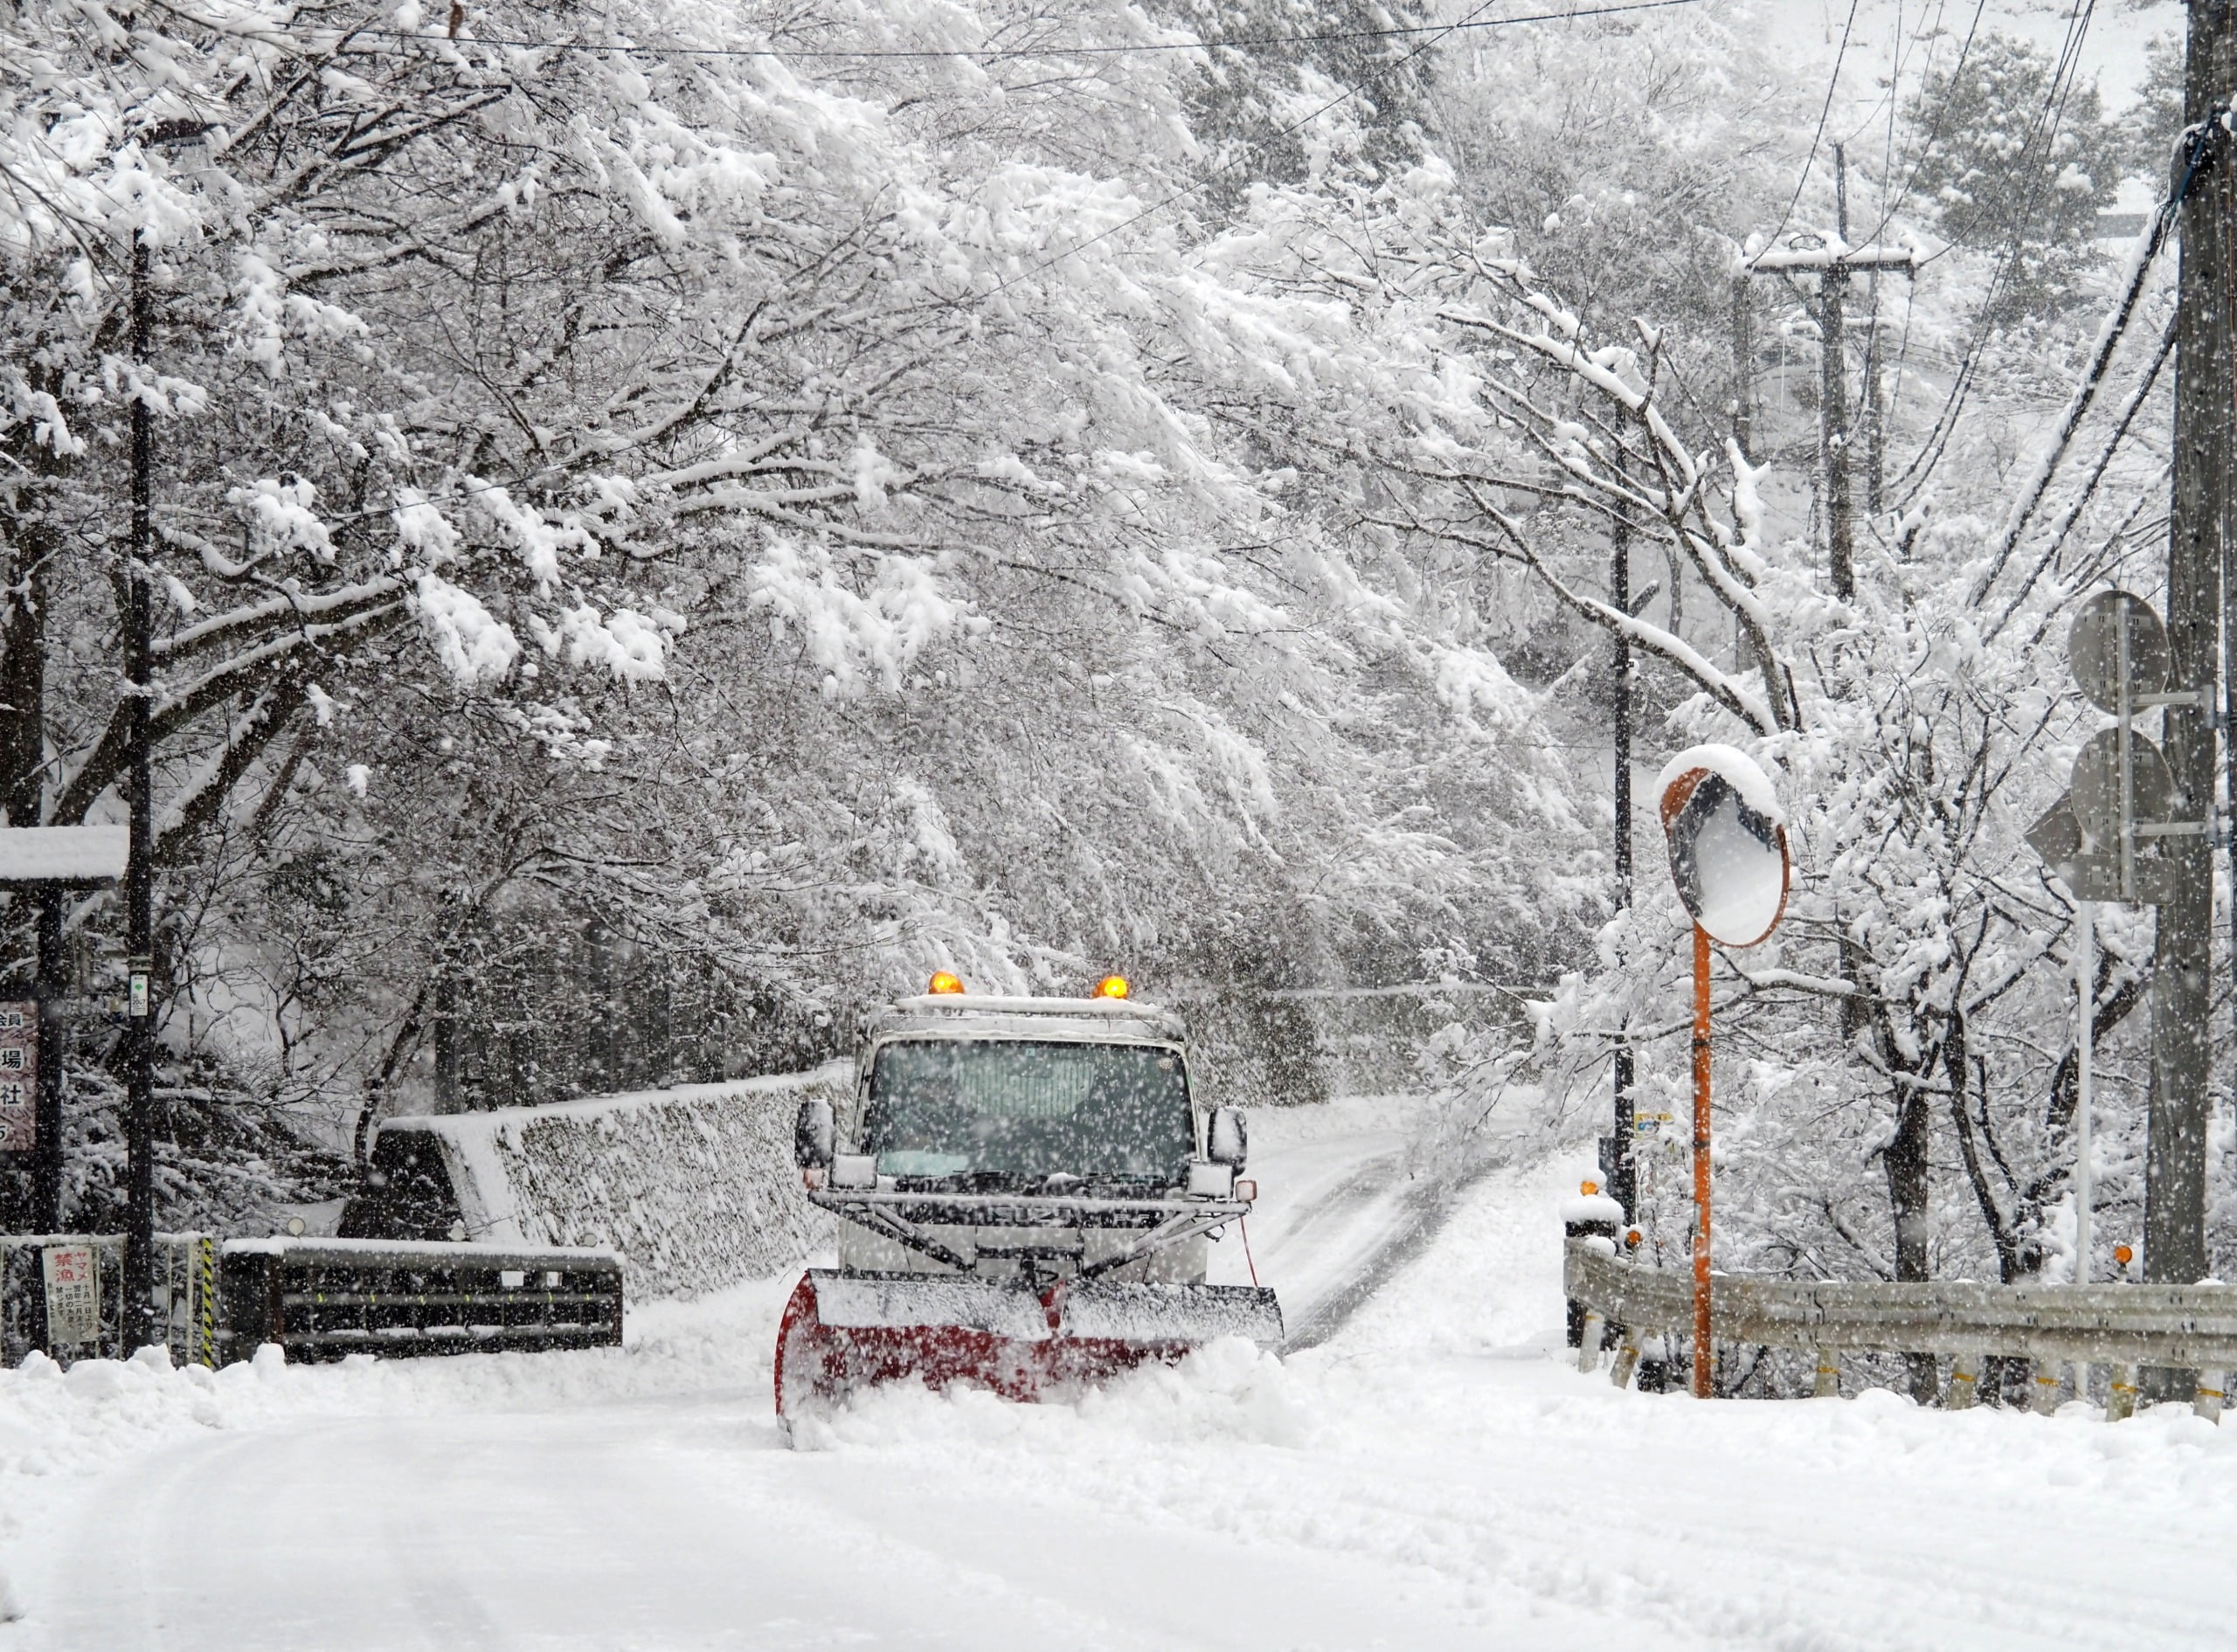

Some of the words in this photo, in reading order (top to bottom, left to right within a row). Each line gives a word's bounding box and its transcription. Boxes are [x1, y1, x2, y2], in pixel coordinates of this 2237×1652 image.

[1, 1050, 22, 1069] 場
[0, 1084, 22, 1105] 社
[987, 1206, 1071, 1223] ISUZU
[54, 1252, 75, 1282] 禁漁
[73, 1251, 87, 1282] ヤマメ
[82, 1283, 93, 1330] 十月一日より
